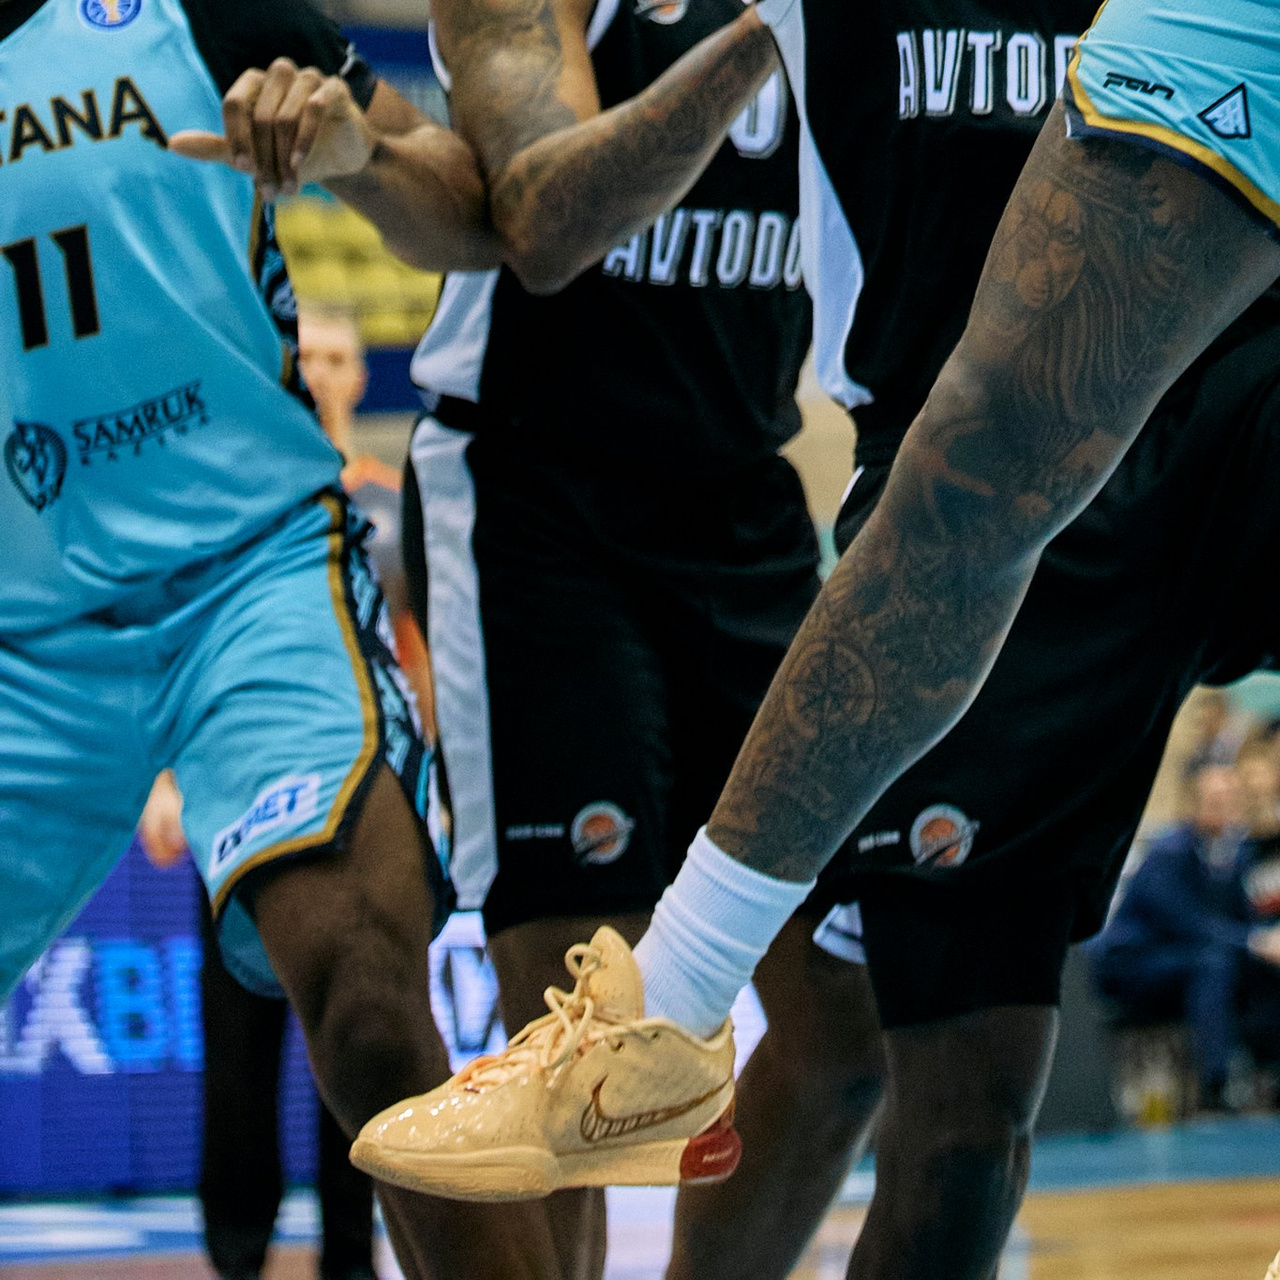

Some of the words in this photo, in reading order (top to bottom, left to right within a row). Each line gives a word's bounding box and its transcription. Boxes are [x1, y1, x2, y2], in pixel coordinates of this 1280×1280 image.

[0, 74, 169, 165] ANA
[0, 223, 101, 353] 11
[72, 380, 206, 454] SAMRUK
